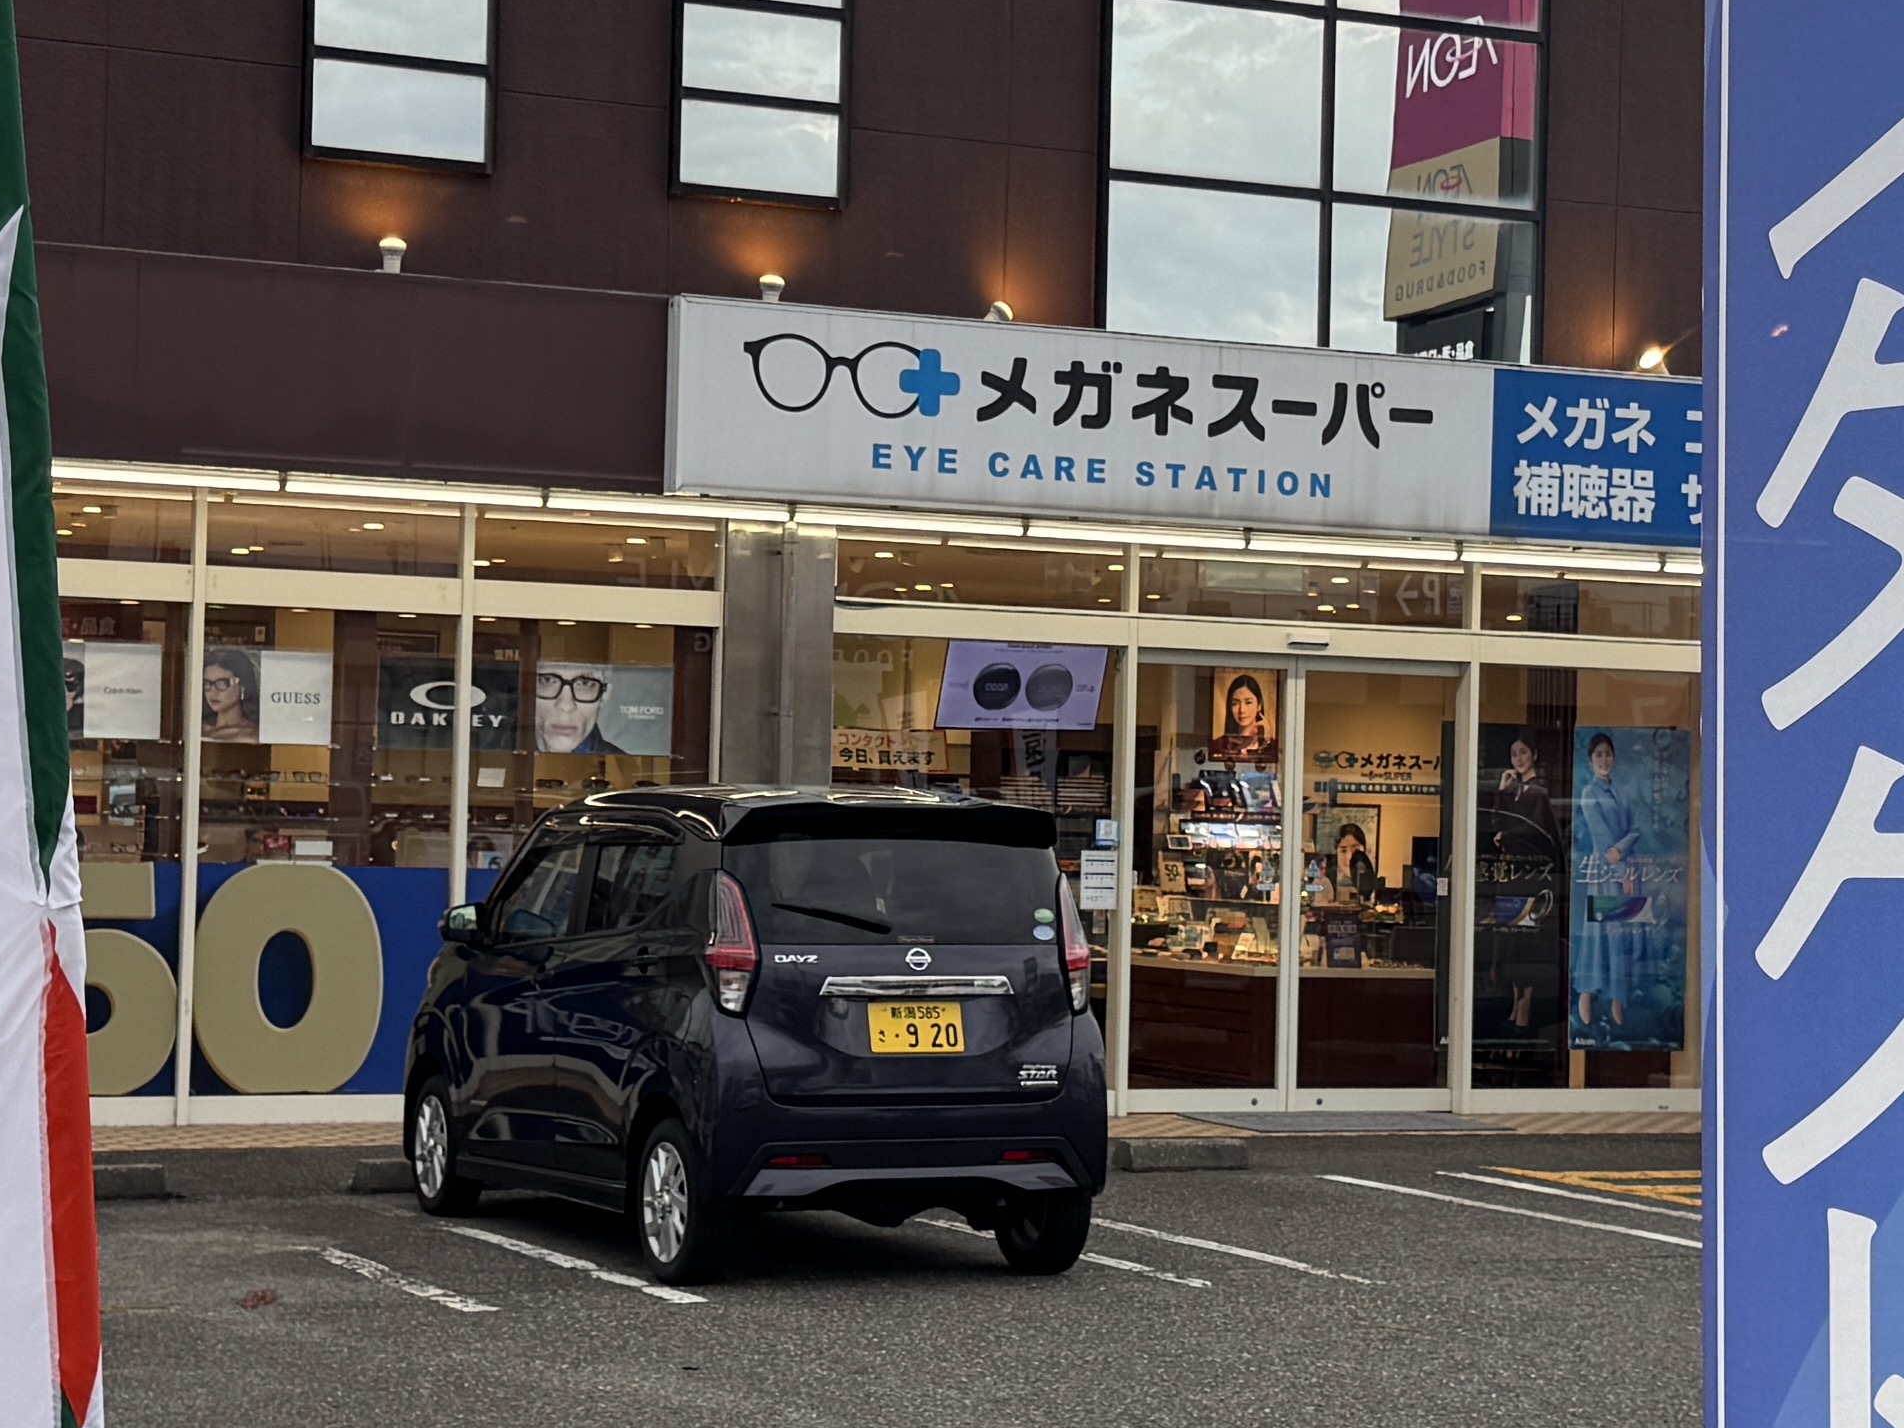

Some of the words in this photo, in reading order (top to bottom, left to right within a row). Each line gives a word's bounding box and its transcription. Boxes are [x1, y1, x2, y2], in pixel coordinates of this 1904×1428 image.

[975, 355, 1434, 450] メガネスーパー
[1516, 395, 1657, 454] メガネ
[870, 443, 960, 476] EYE
[988, 450, 1109, 485] CARE
[1135, 460, 1335, 500] STATION
[1513, 459, 1656, 524] 補聴器
[270, 691, 322, 705] GUESS
[389, 710, 504, 729] OAKEY
[837, 732, 896, 749] コンタクト
[839, 747, 936, 766] 今日、買えます
[773, 953, 819, 964] DAYZ
